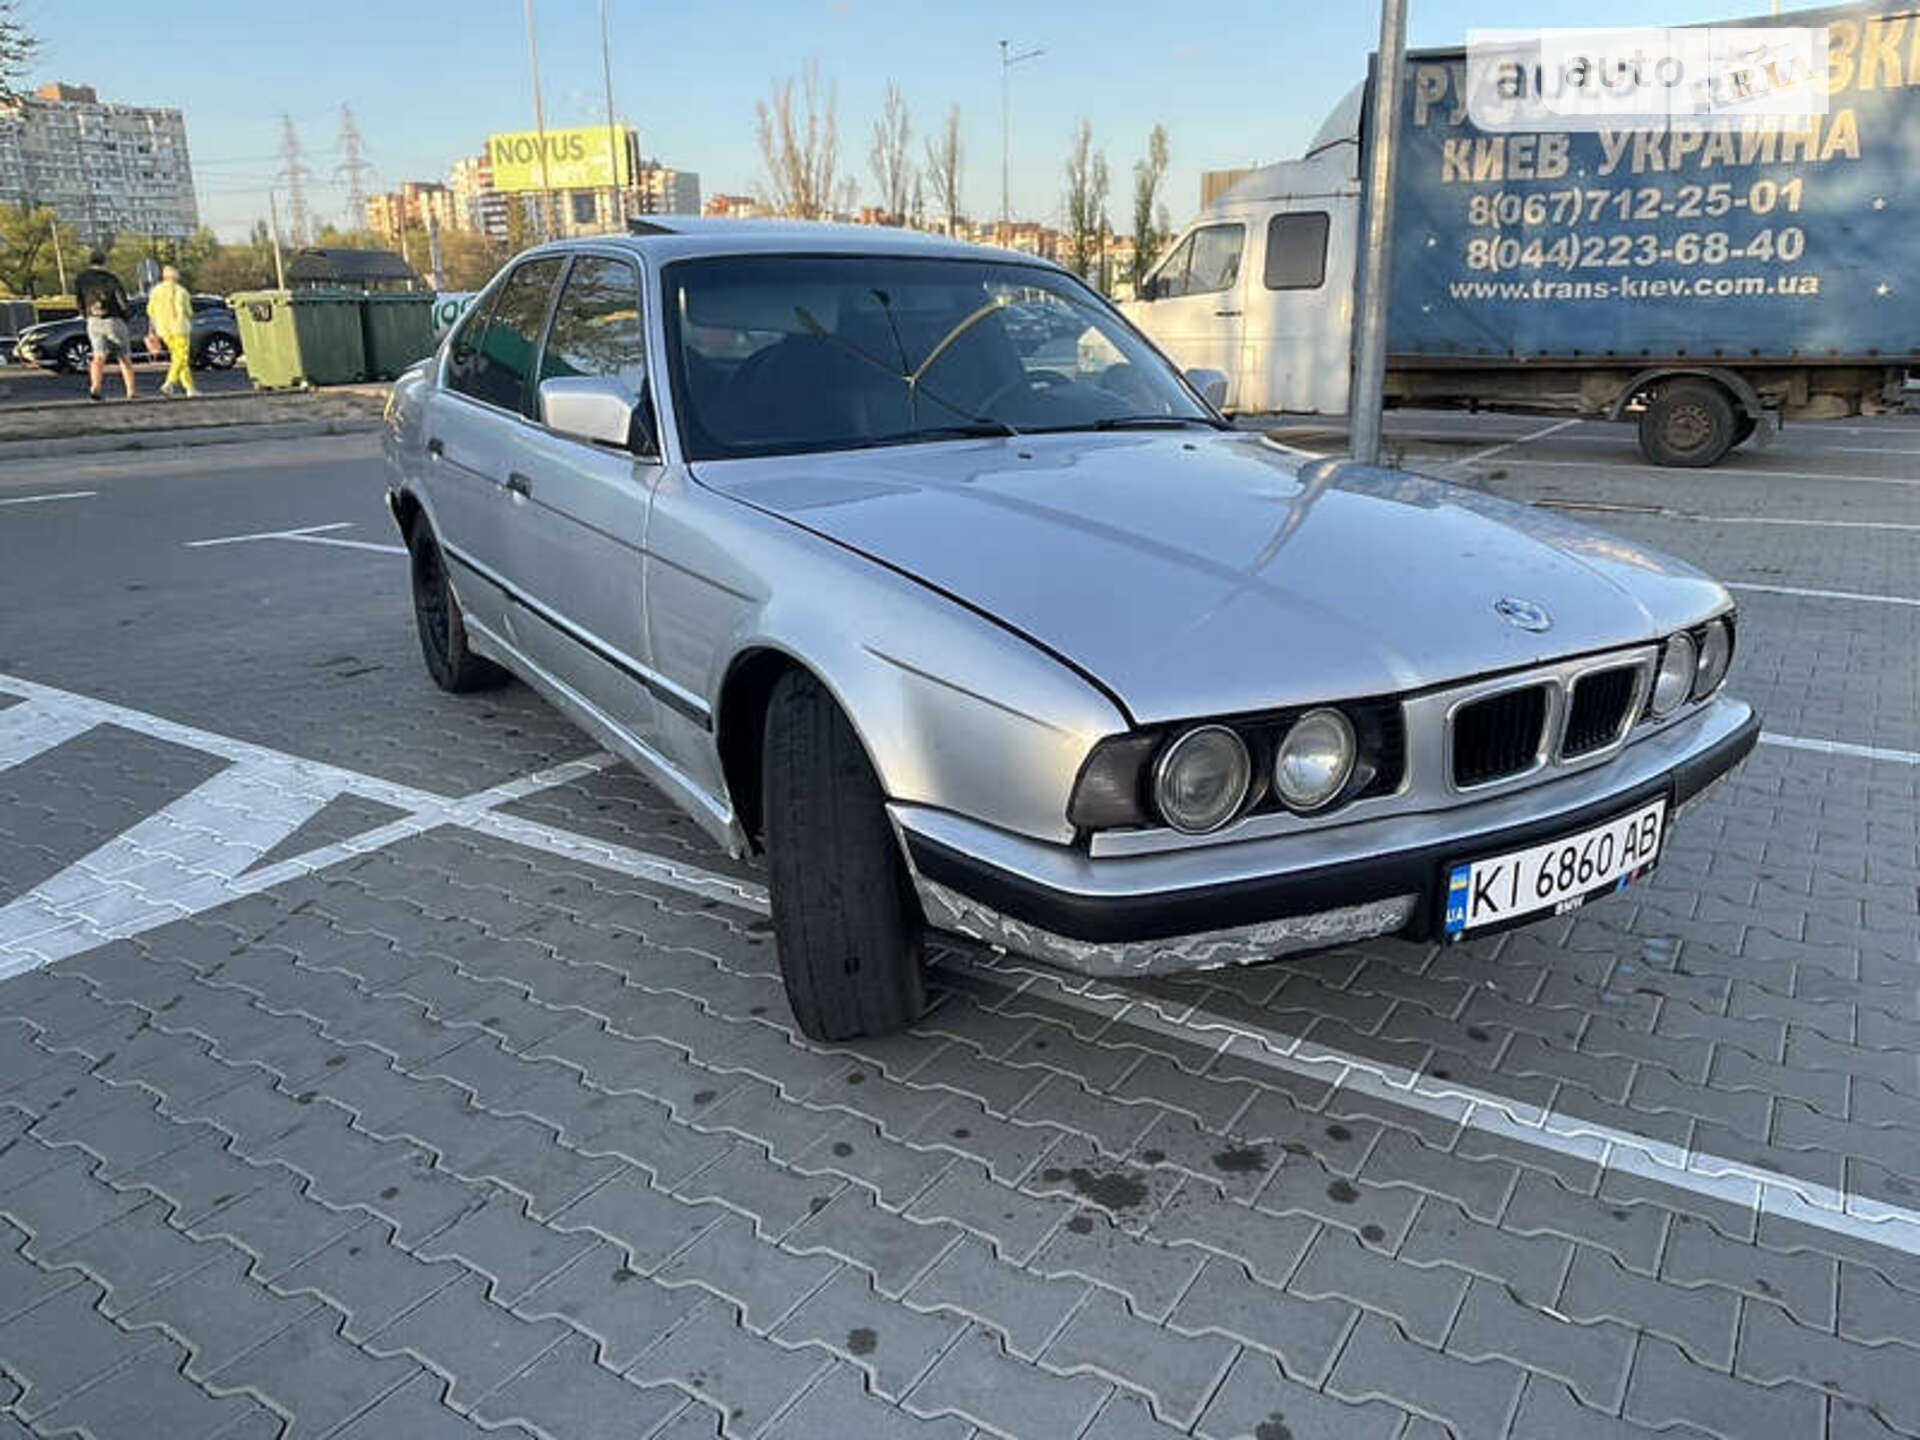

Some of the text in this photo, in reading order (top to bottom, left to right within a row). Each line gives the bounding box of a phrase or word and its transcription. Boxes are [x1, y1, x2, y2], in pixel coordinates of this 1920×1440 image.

[495, 134, 585, 165] NOVUS
[1598, 107, 1863, 177] УКРАИНА
[1467, 177, 1805, 229] 8(067)712-25-01
[1465, 227, 1806, 272] 8(044)223-68-40
[1449, 273, 1821, 302] www.trans-kiev.com.ua
[1472, 812, 1658, 918] KI 6860 AB
[1446, 907, 1465, 922] UA
